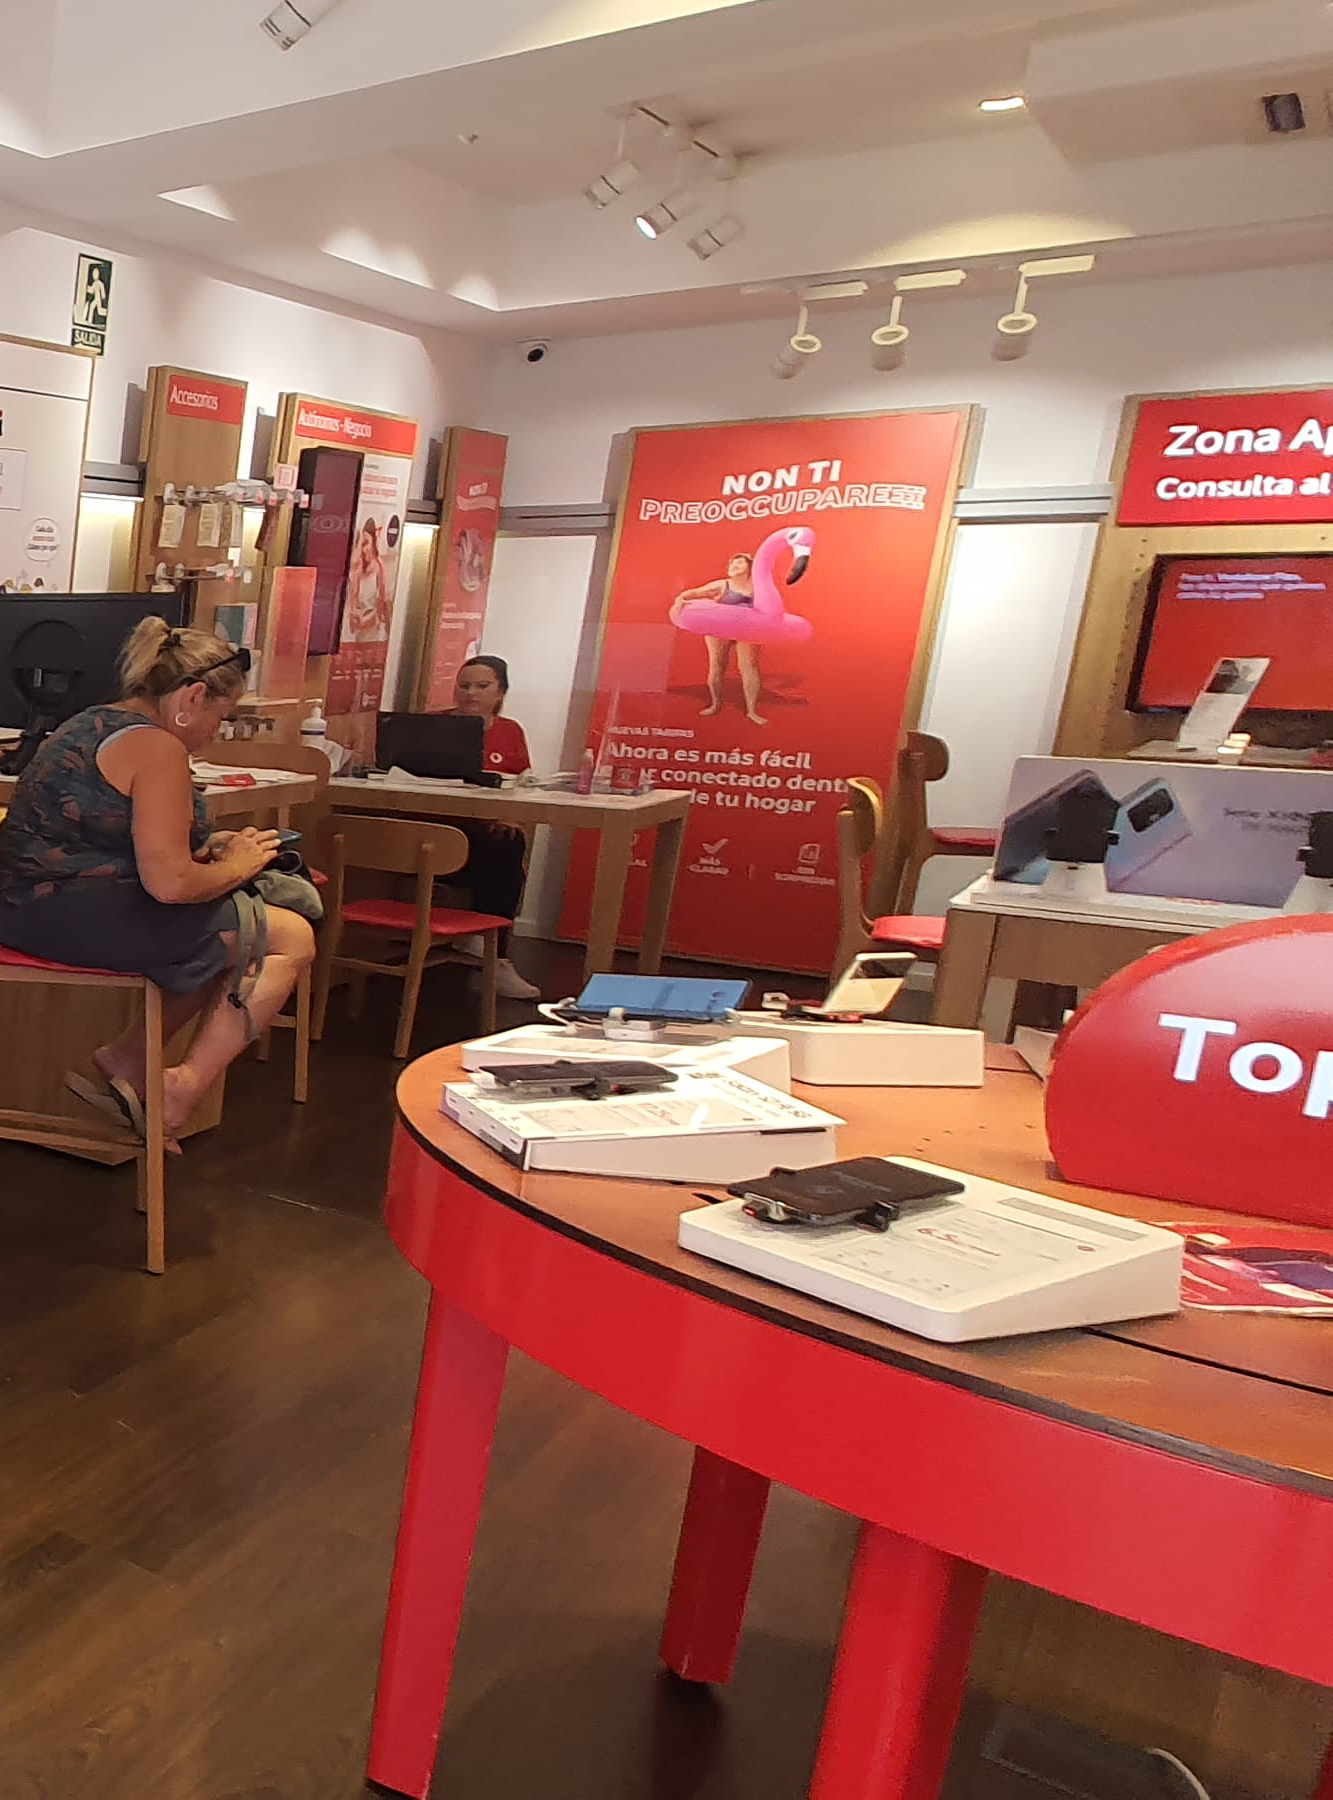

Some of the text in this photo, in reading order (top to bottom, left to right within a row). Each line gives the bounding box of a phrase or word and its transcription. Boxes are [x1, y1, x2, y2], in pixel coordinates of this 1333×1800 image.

[1163, 424, 1282, 457] Zona
[722, 459, 843, 496] NON TI
[1156, 472, 1331, 500] Consulta al
[607, 741, 812, 770] Ahora es más fácil
[661, 769, 781, 789] conectado
[715, 791, 816, 814] tu hogar
